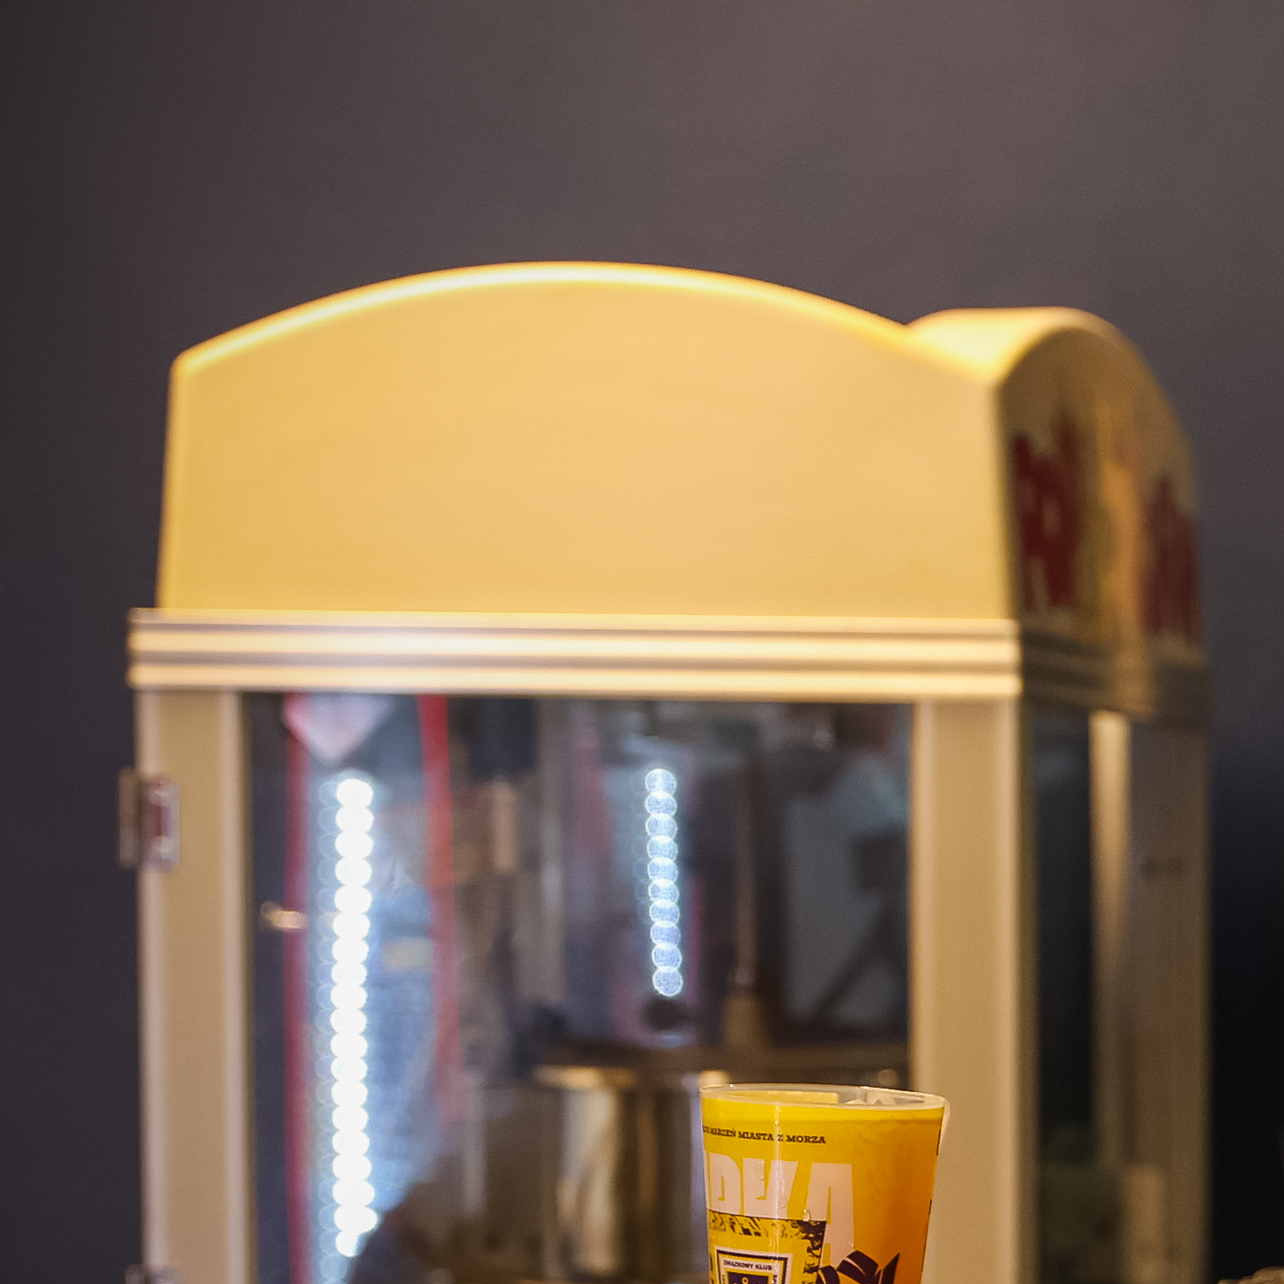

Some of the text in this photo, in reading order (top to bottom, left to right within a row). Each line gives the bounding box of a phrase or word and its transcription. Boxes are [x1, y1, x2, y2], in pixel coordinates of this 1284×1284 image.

[738, 1130, 775, 1142] MIASTA
[776, 1133, 784, 1142] Z
[785, 1134, 827, 1145] MORZA
[755, 1261, 773, 1271] KLUB
